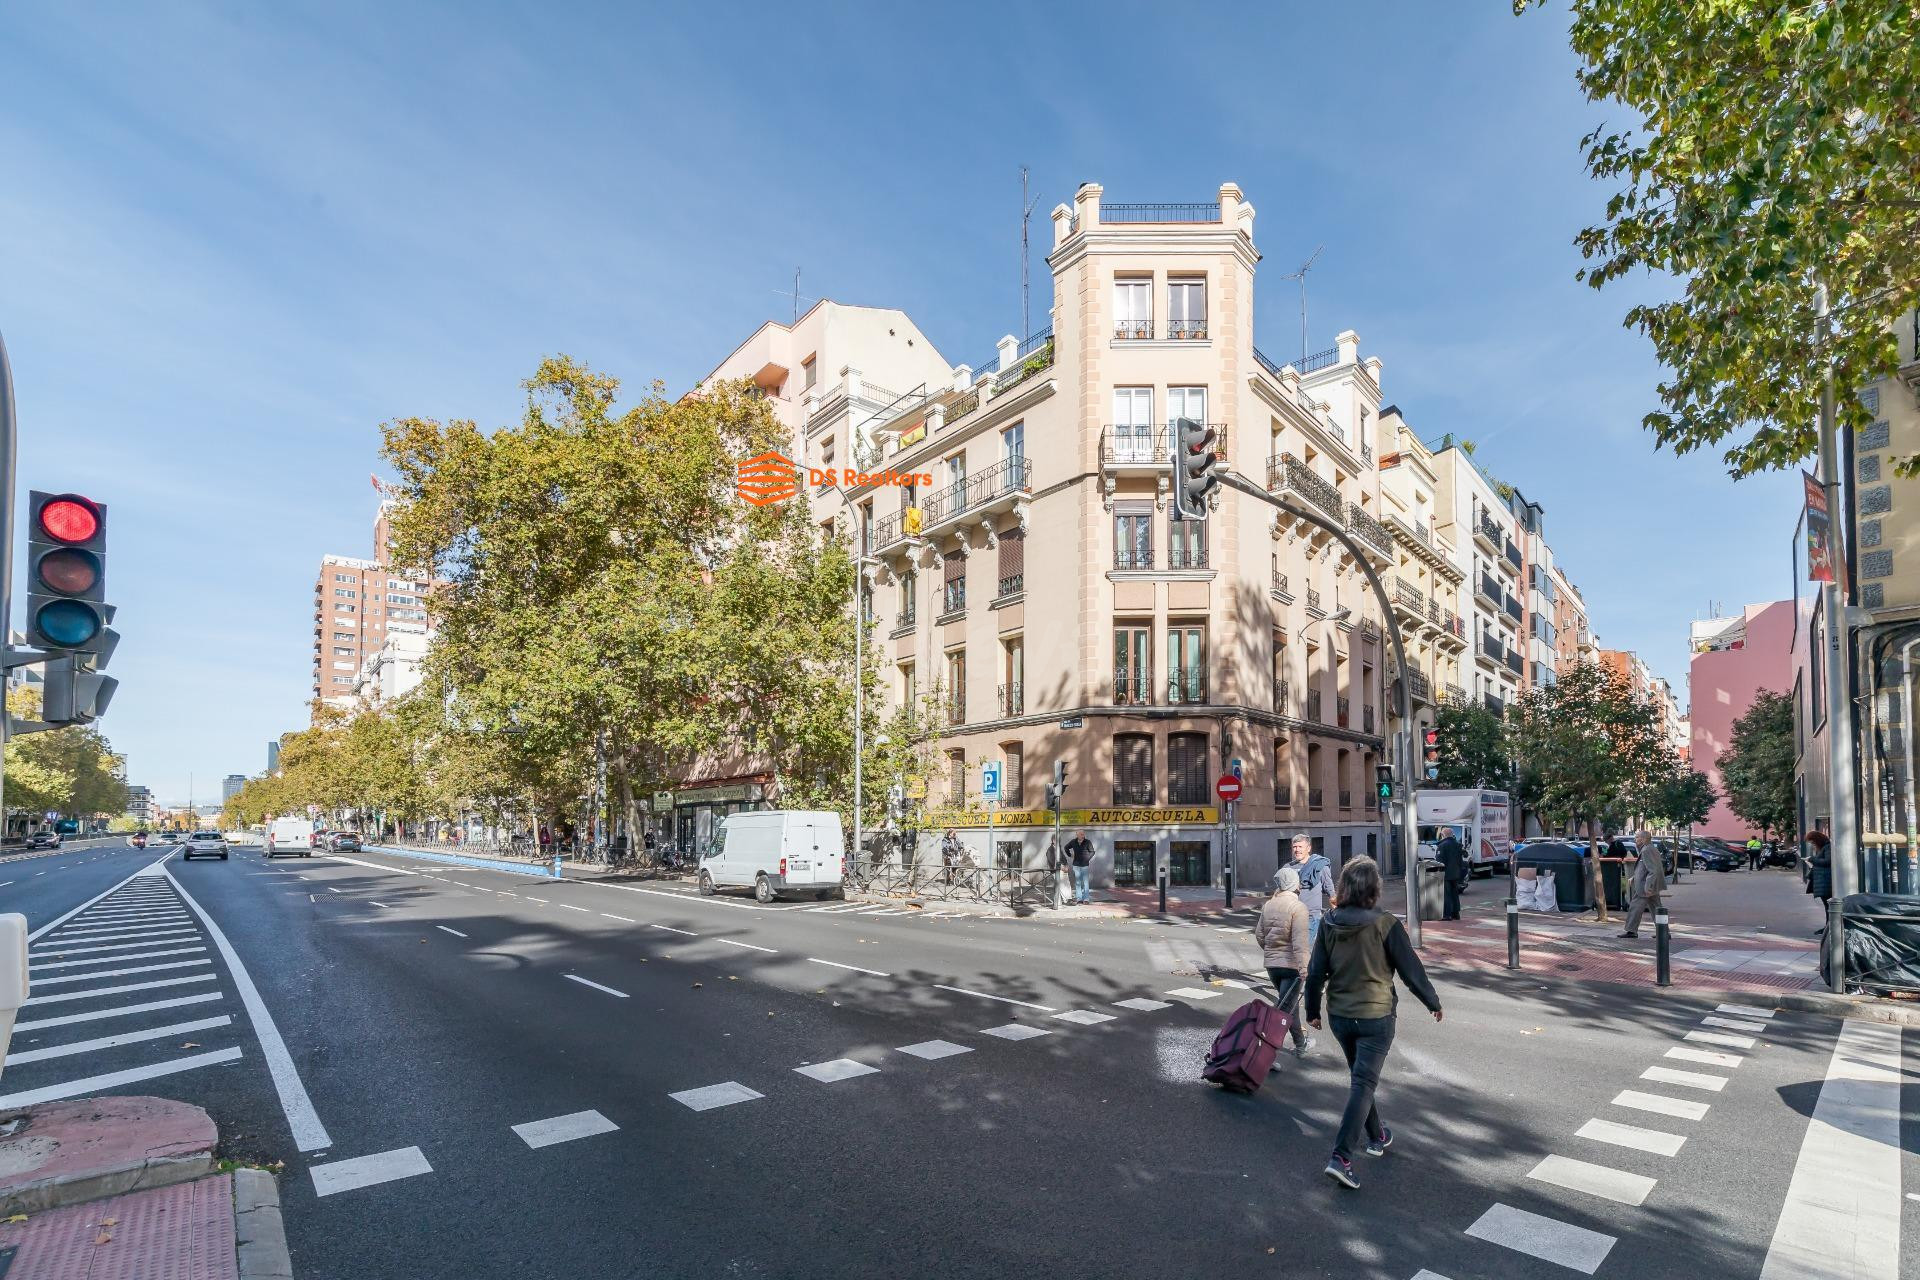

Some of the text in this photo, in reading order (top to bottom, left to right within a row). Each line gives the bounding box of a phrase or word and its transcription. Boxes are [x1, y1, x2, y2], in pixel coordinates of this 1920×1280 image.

[984, 773, 994, 791] P
[1000, 813, 1032, 824] MONZA
[1089, 810, 1205, 822] AUTOESCUELA
